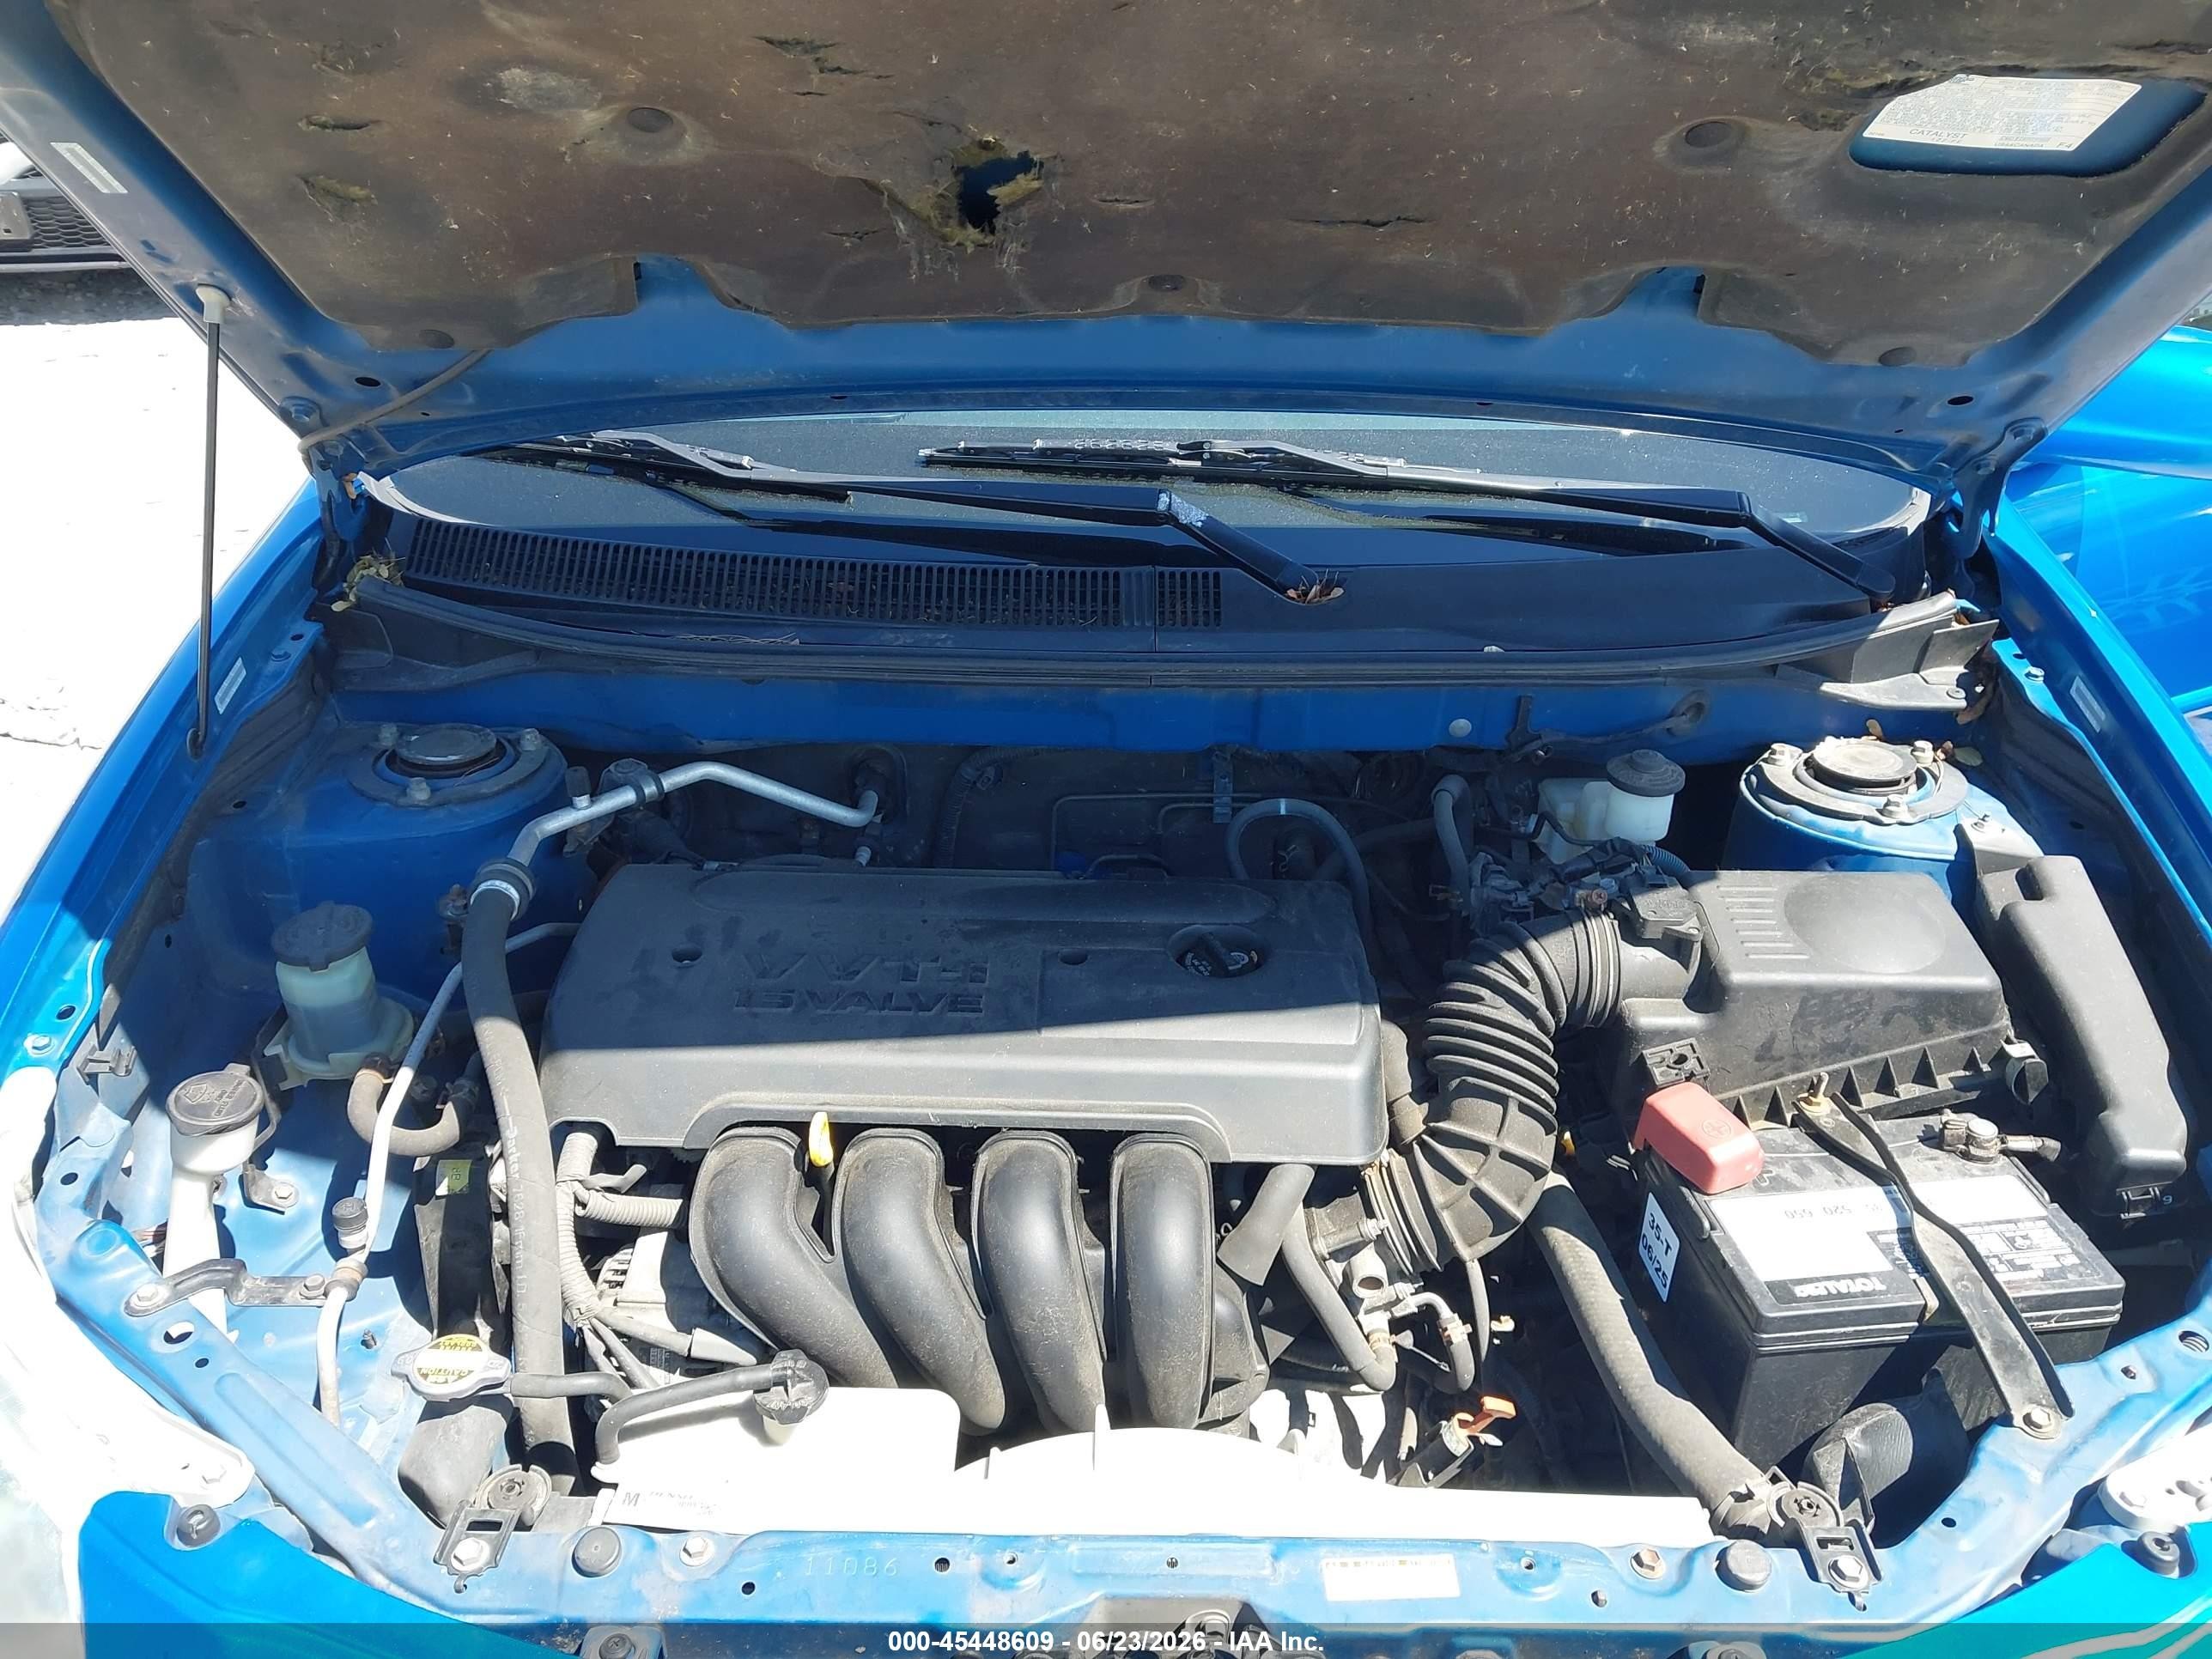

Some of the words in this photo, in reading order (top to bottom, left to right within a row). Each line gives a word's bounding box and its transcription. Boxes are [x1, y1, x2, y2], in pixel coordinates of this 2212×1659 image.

[1909, 128, 1968, 140] CATALYST
[804, 989, 986, 1016] VALVE
[1648, 1212, 1673, 1257] 35-T
[1641, 1232, 1668, 1289] 06/25
[420, 1367, 470, 1376] CAUTION
[621, 1492, 641, 1508] M
[806, 1556, 897, 1577] 11086
